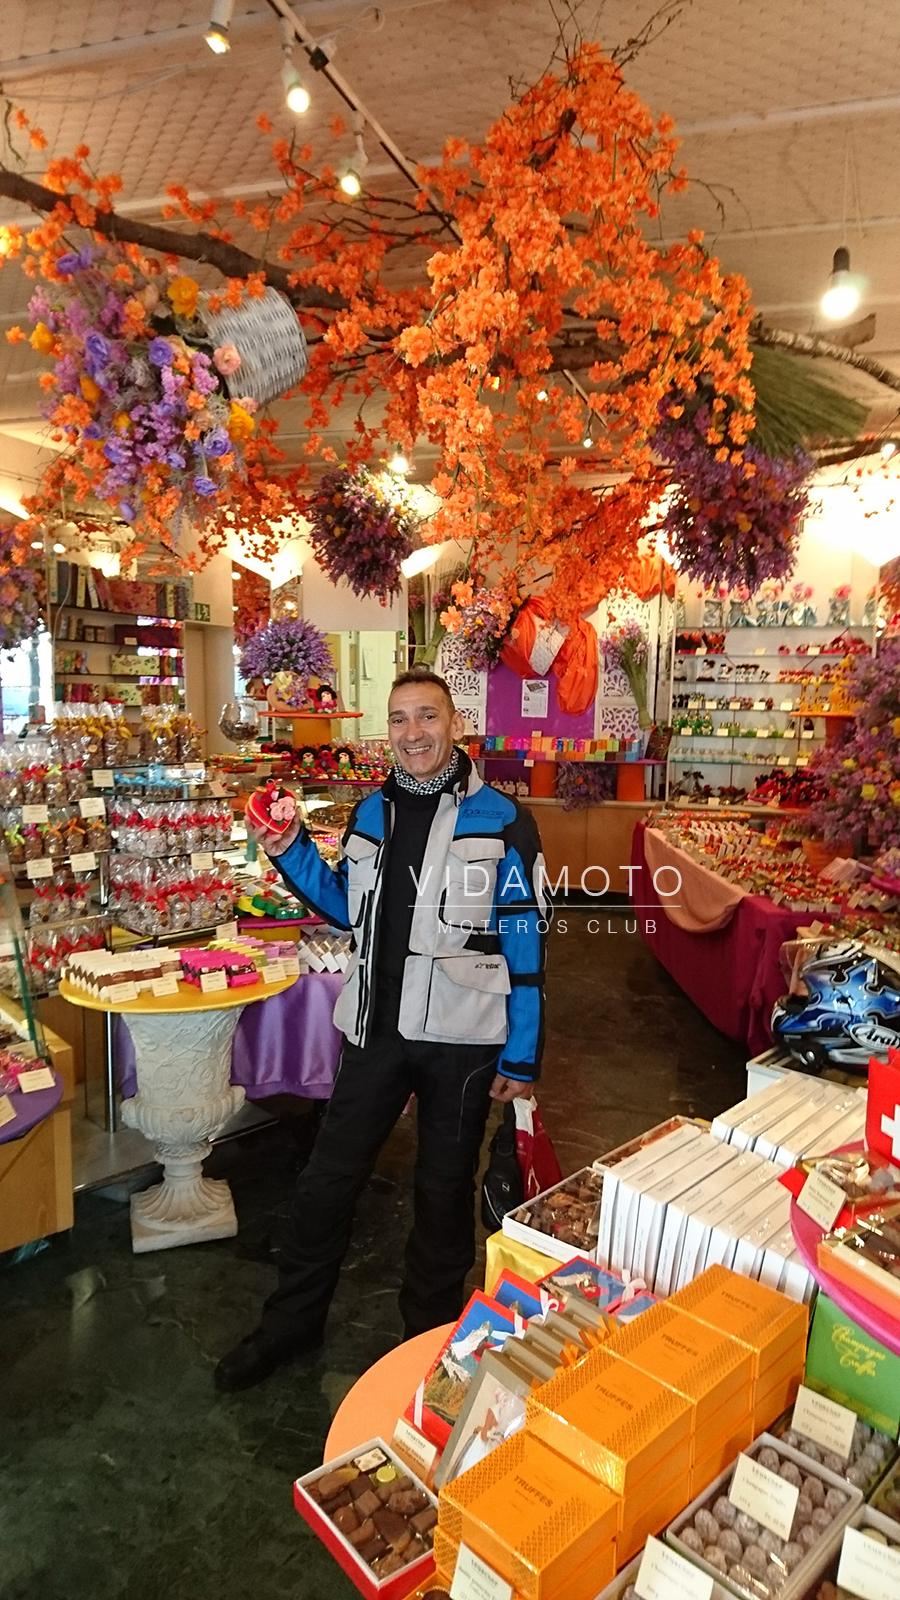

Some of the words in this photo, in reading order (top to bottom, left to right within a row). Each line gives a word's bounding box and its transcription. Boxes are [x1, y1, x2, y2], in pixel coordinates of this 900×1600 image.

[661, 1333, 699, 1357] TRUFFES
[595, 1384, 633, 1411] TRUFFES
[514, 1475, 554, 1507] TRUFFES
